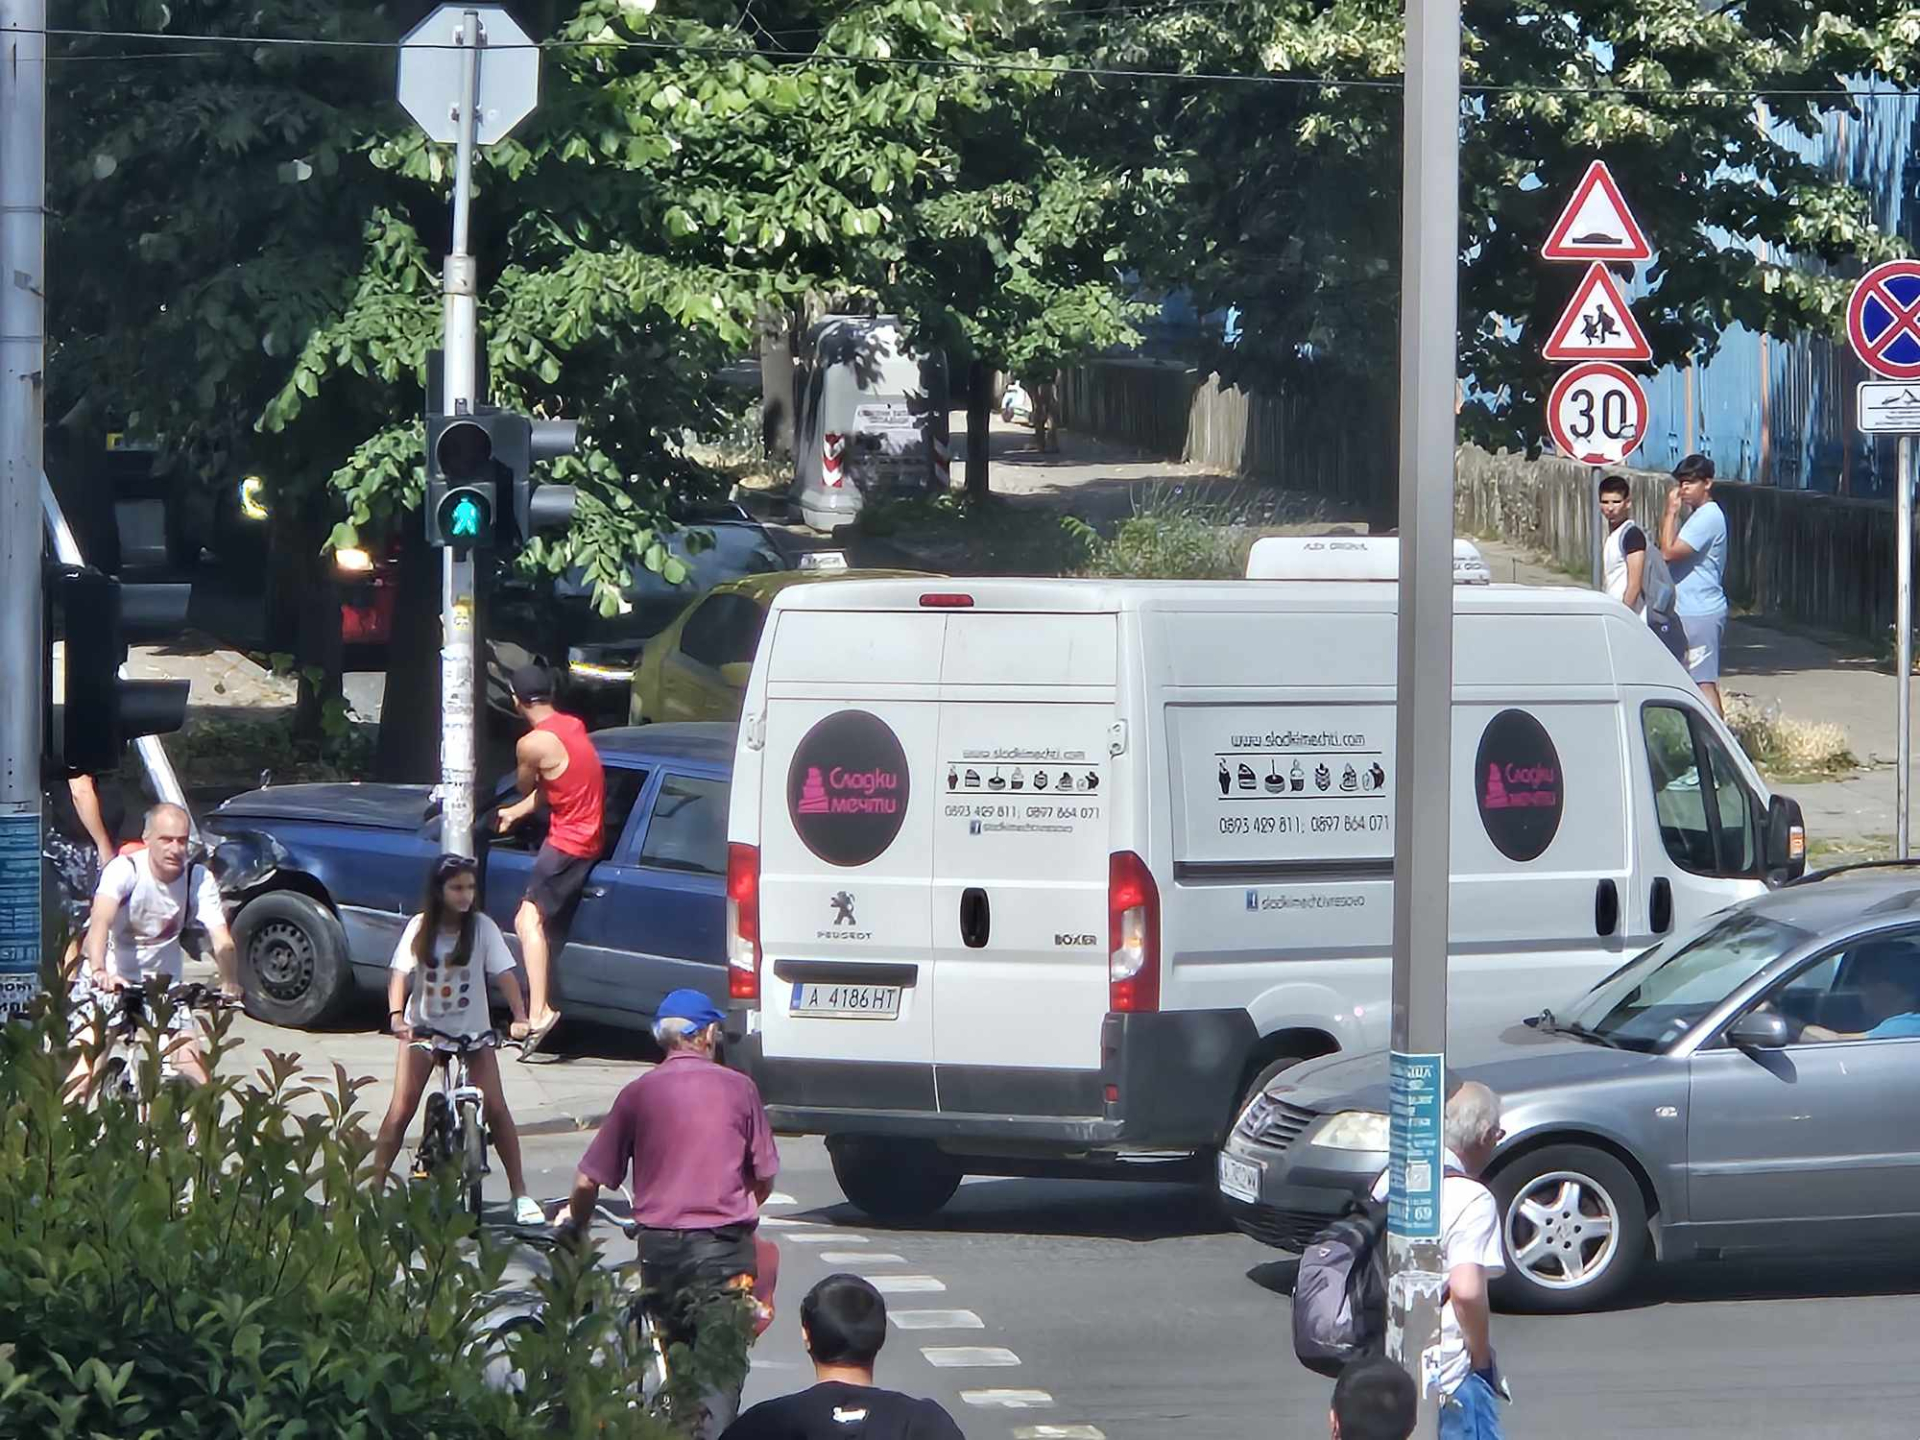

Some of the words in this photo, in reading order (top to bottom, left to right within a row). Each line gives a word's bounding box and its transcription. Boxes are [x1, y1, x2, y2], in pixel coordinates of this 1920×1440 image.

[1570, 388, 1627, 439] 30
[817, 931, 873, 940] PEUGEOT
[1055, 934, 1097, 945] BOXER
[809, 987, 818, 1007] A
[829, 987, 869, 1009] 4186
[872, 989, 897, 1009] HT
